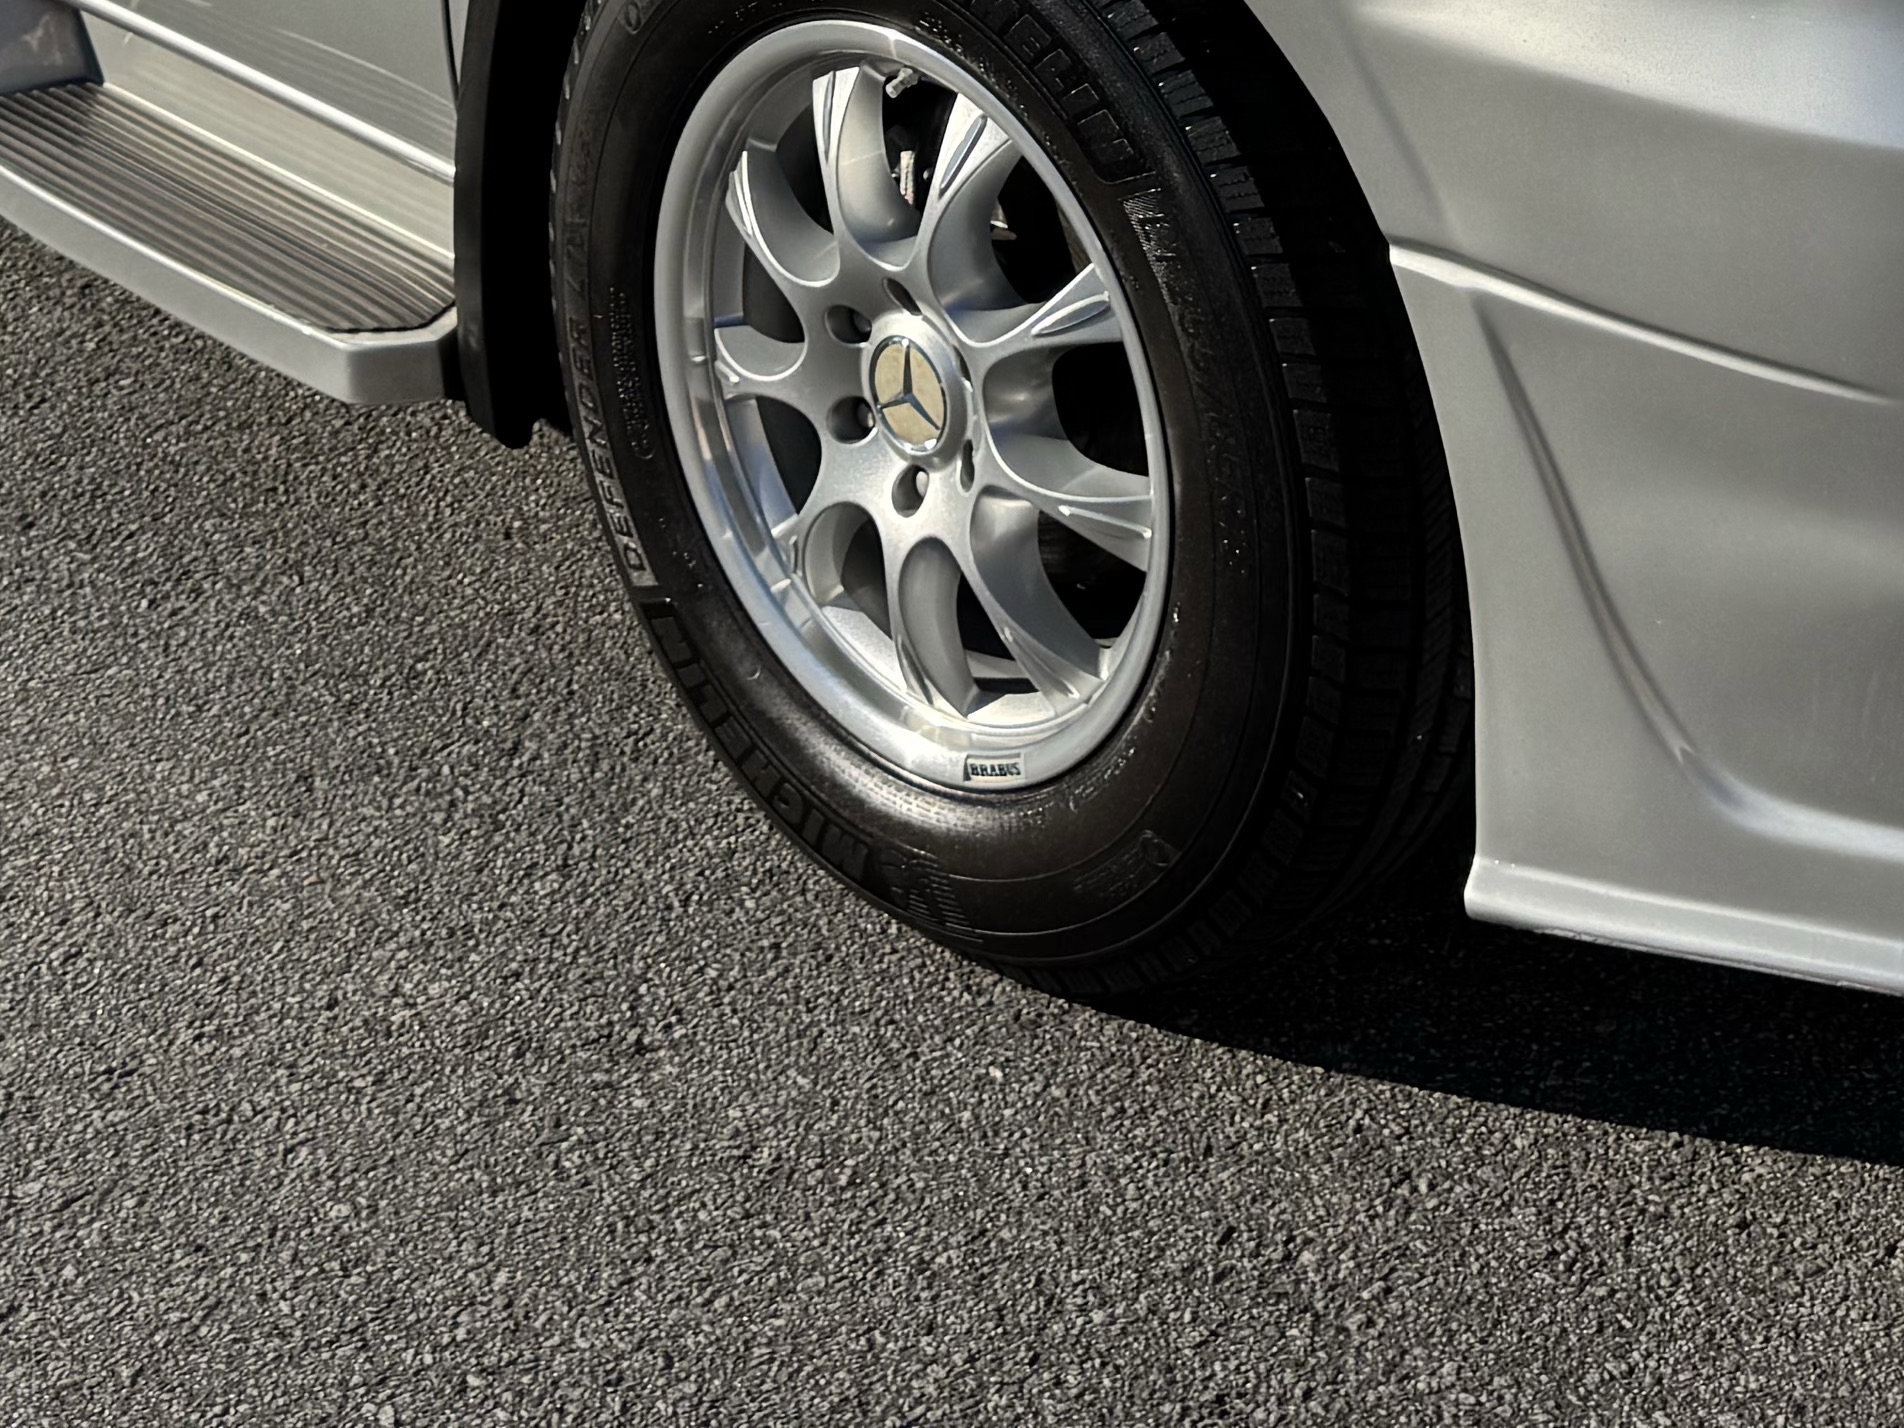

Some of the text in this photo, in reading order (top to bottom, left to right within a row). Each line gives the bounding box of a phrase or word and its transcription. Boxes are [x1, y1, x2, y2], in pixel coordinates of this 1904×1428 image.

[569, 316, 647, 575] DEFENDER
[649, 614, 871, 886] MICHELIN
[969, 761, 1022, 777] BRABUS
